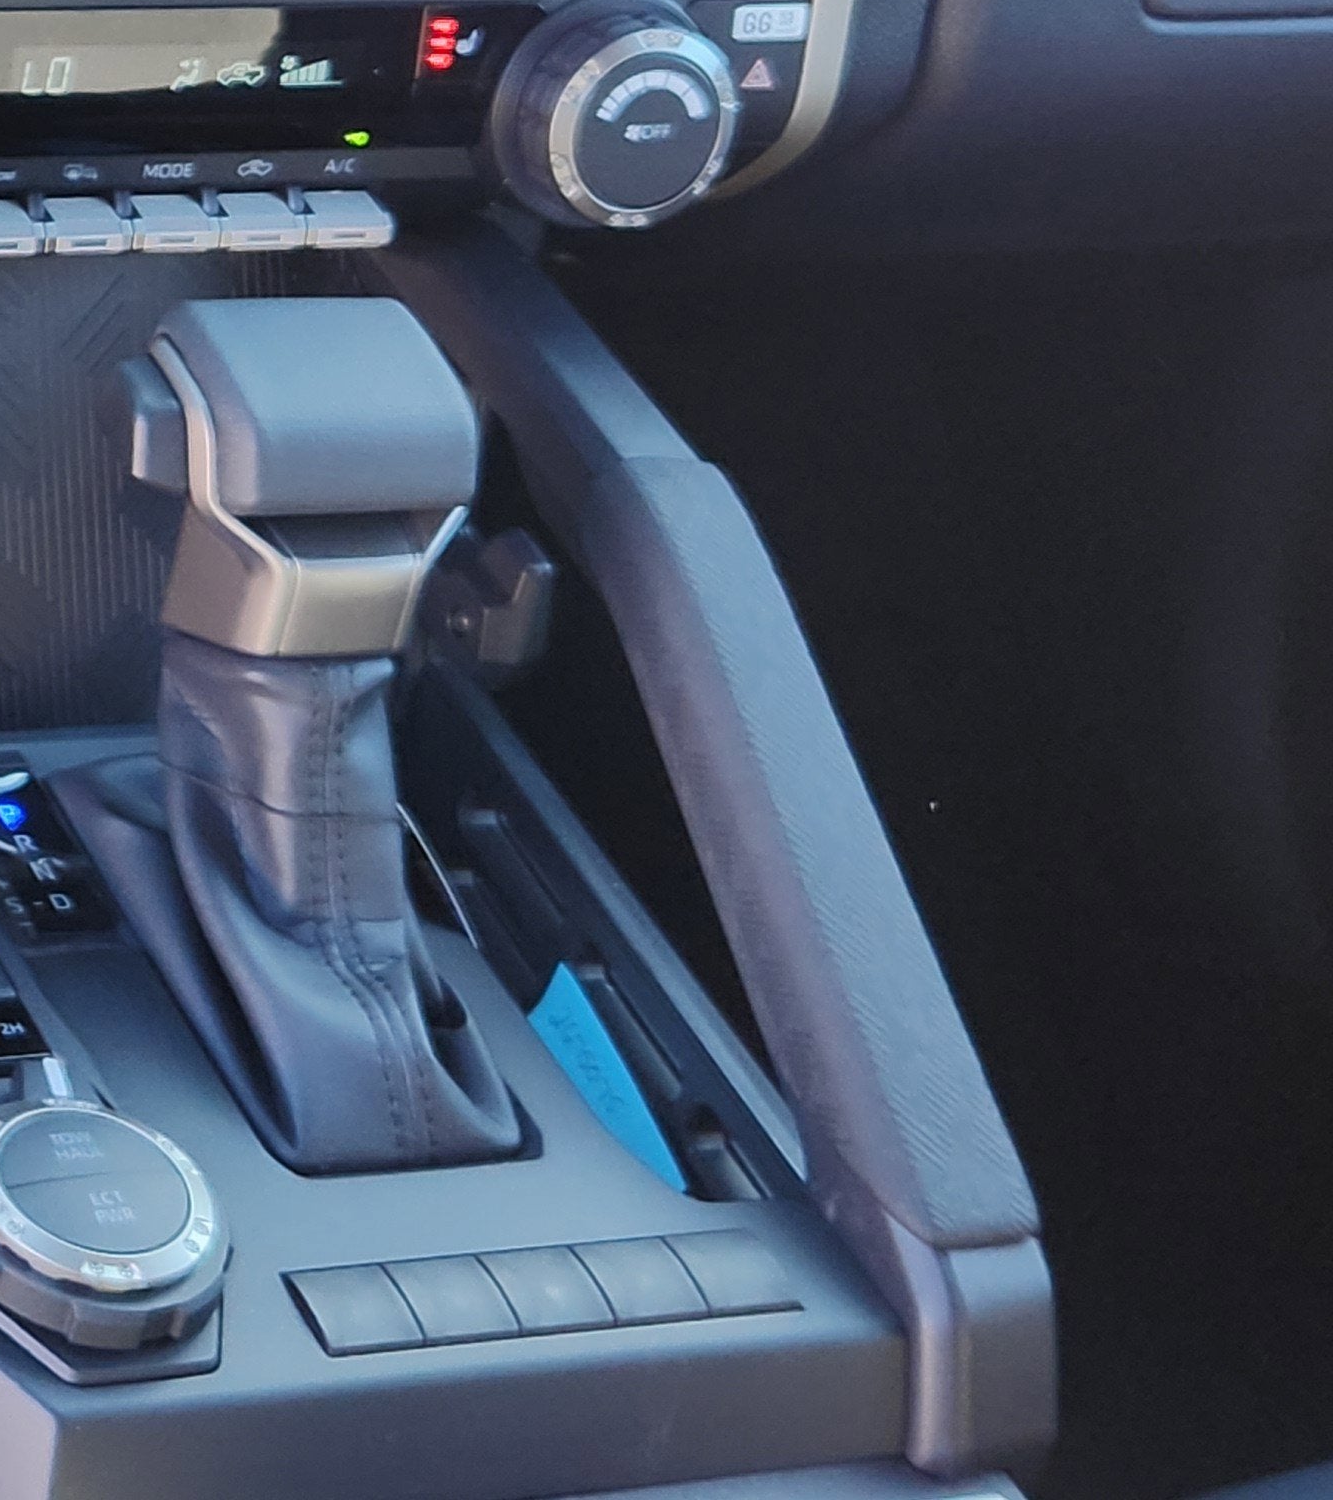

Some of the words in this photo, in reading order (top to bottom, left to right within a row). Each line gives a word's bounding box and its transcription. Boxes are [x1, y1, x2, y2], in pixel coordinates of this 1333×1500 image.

[142, 162, 195, 179] MODE
[324, 158, 357, 175] A/C
[13, 834, 39, 853] R
